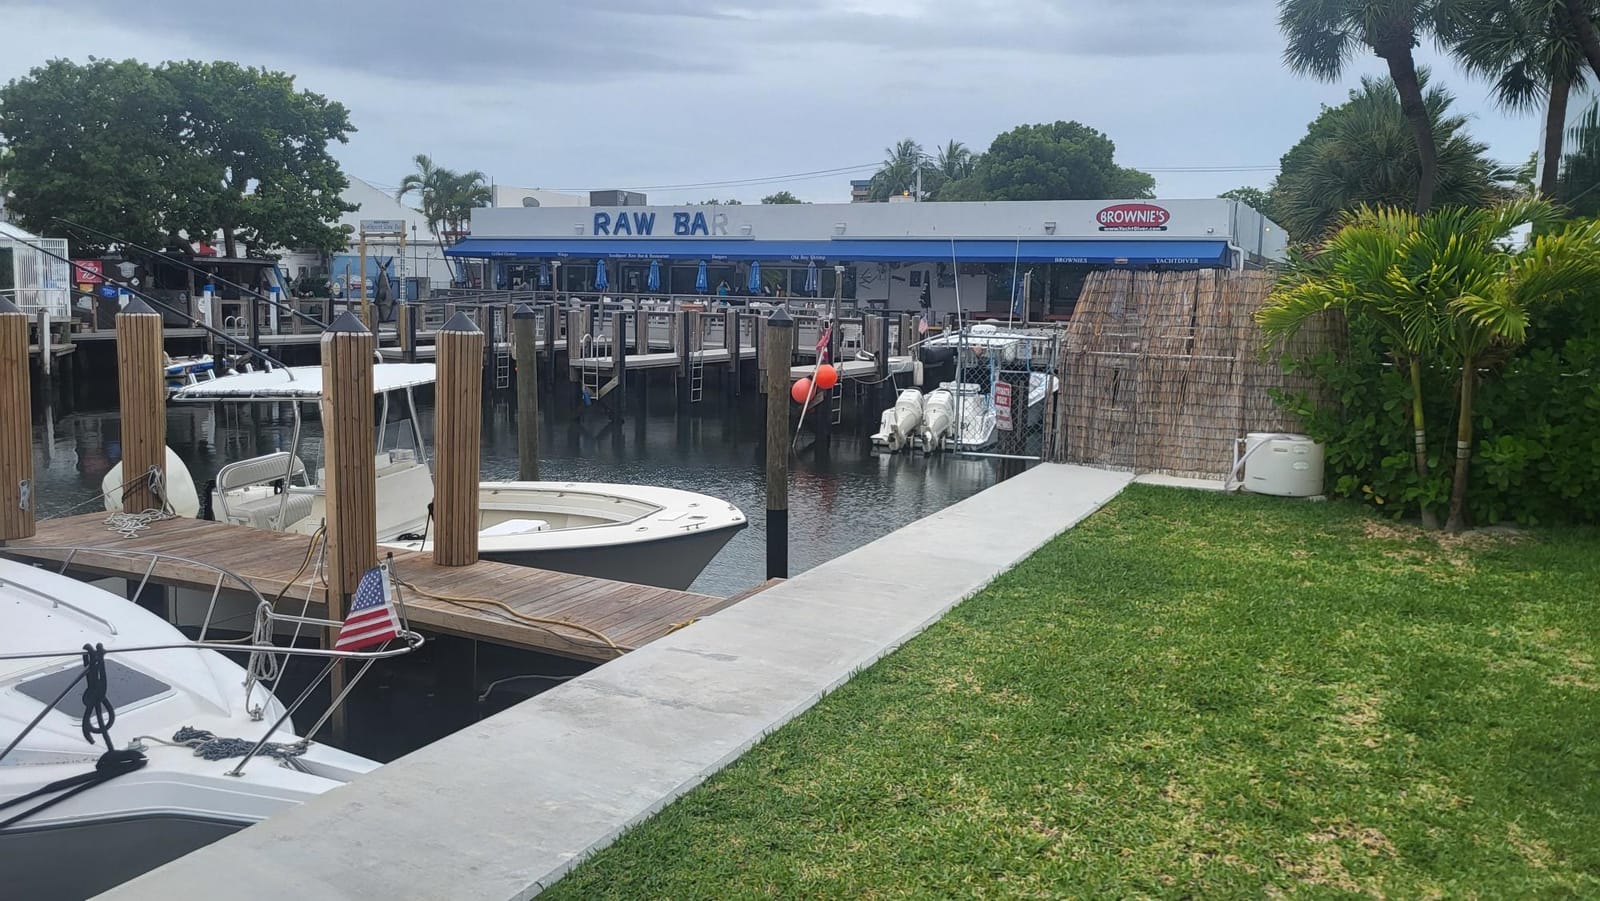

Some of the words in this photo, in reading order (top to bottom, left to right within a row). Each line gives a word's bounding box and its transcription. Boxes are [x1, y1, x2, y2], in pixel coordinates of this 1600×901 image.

[1100, 209, 1165, 223] BROWNIE'S
[593, 212, 656, 236] RAW
[673, 211, 729, 236] BAR
[1054, 256, 1088, 264] BROWNIES
